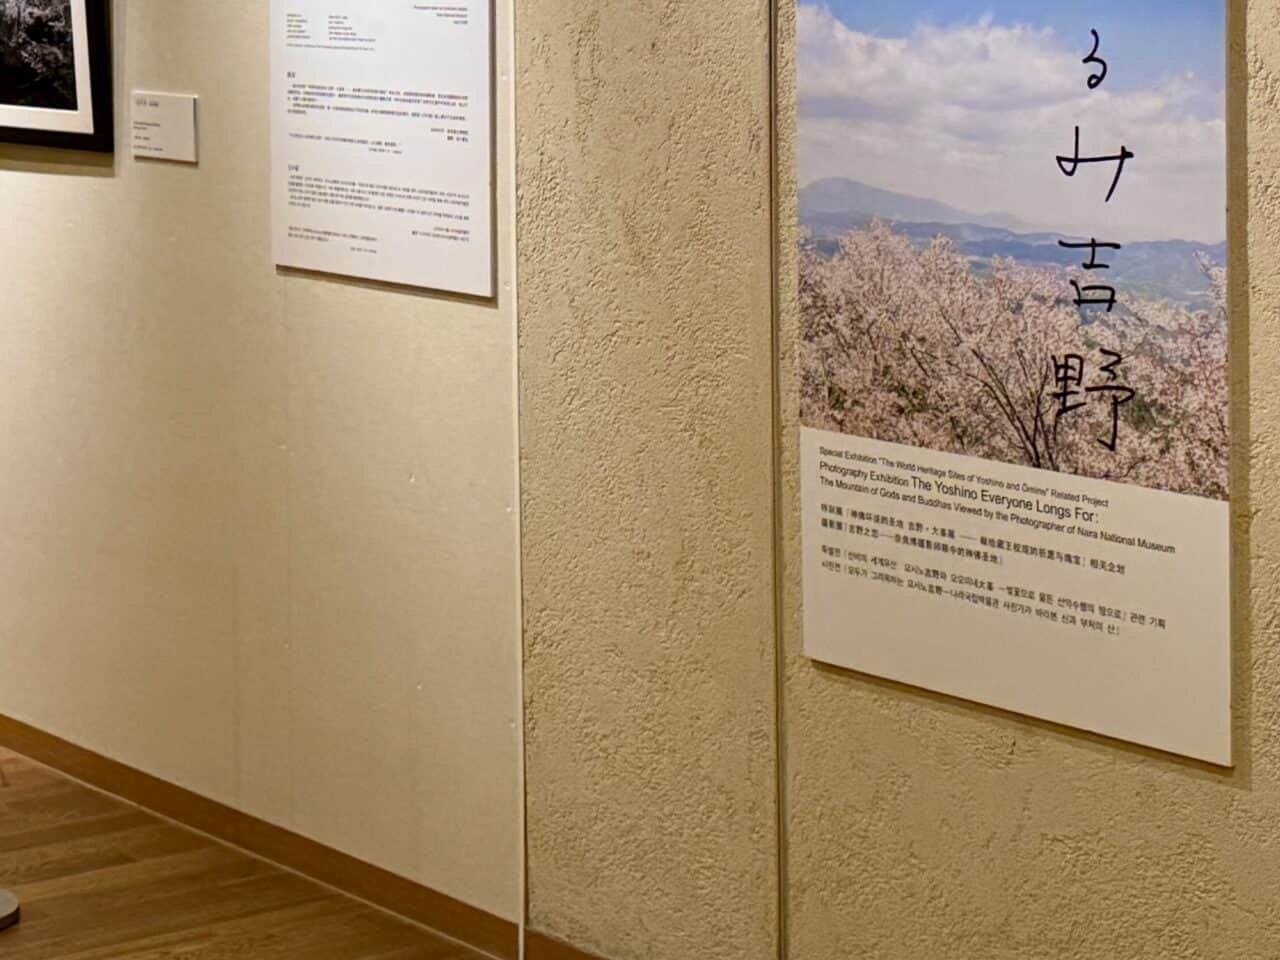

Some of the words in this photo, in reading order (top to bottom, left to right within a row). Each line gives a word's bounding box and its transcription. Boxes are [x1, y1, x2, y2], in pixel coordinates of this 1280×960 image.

[819, 447, 843, 458] Special
[844, 450, 877, 464] Exhibition
[896, 461, 916, 472] World
[917, 466, 946, 478] Heritage
[948, 470, 965, 480] Sites
[967, 474, 974, 482] of
[976, 475, 1004, 488] Yoshino
[1006, 481, 1020, 491] and
[1051, 489, 1080, 502] Related
[1082, 494, 1109, 507] Project
[820, 461, 868, 481] Photography
[870, 471, 909, 486] Exhibition
[912, 476, 932, 491] The
[934, 481, 977, 499] Yoshino
[981, 490, 1033, 510] Everyone
[1036, 500, 1071, 519] Longs
[1075, 507, 1099, 524] For:
[820, 476, 834, 486] The
[836, 480, 869, 493] Mountain
[880, 488, 900, 500] Gods
[902, 493, 916, 503] and
[918, 496, 952, 510] Buddhas
[954, 503, 982, 516] Viewed
[984, 509, 994, 520] by
[996, 512, 1008, 522] the
[1010, 513, 1066, 530] Photographer
[1067, 526, 1075, 534] of
[1078, 526, 1098, 538] Nara
[1100, 531, 1136, 546] National
[1138, 538, 1176, 553] Museum
